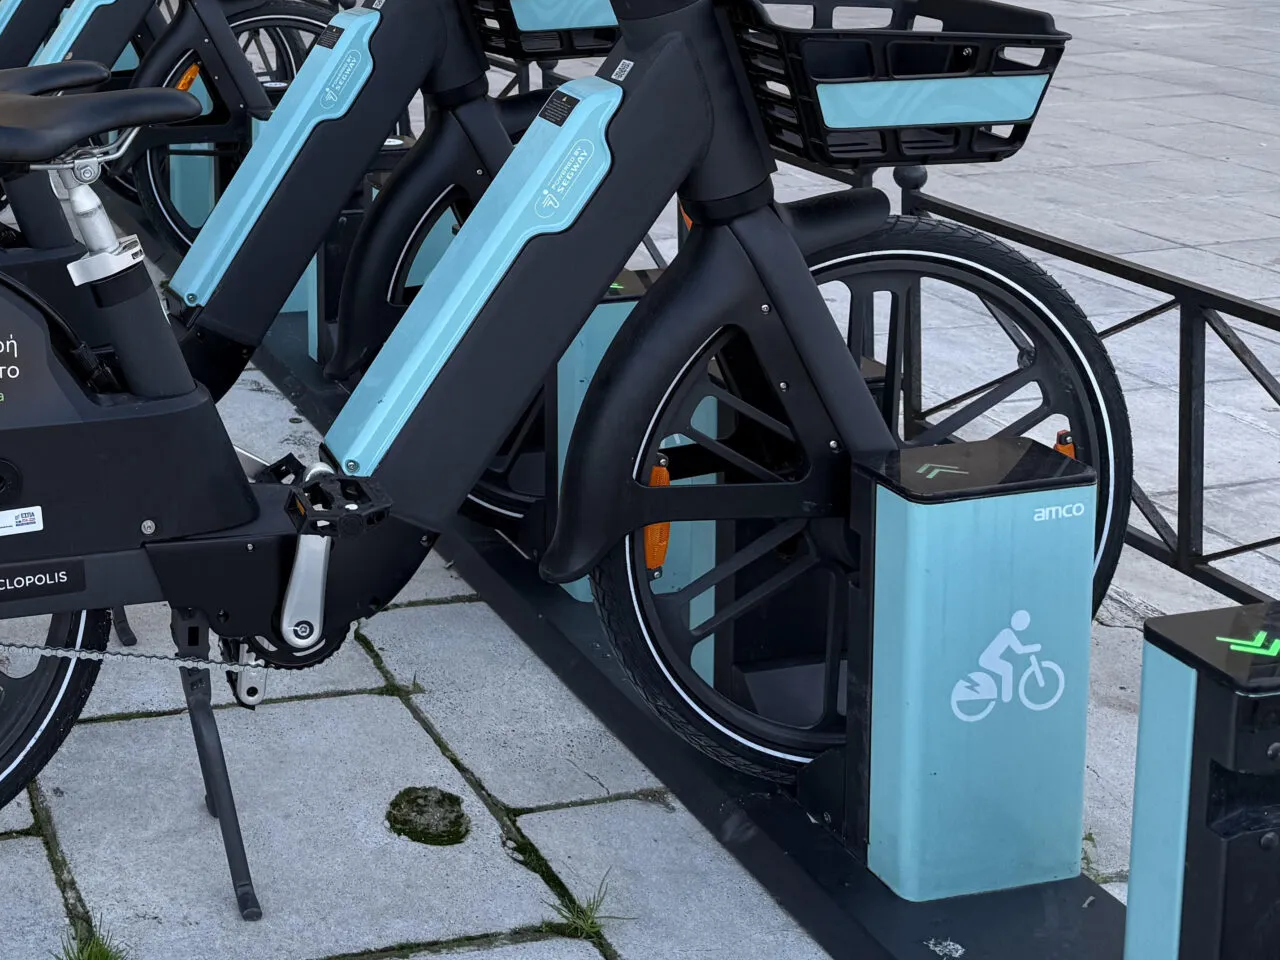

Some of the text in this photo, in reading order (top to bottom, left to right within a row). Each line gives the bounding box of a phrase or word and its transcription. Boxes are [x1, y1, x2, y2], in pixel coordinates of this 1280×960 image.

[336, 57, 358, 91] SEGWAY
[551, 146, 582, 190] POWERED BY
[556, 149, 588, 194] SEGWAY
[1033, 502, 1085, 522] amco
